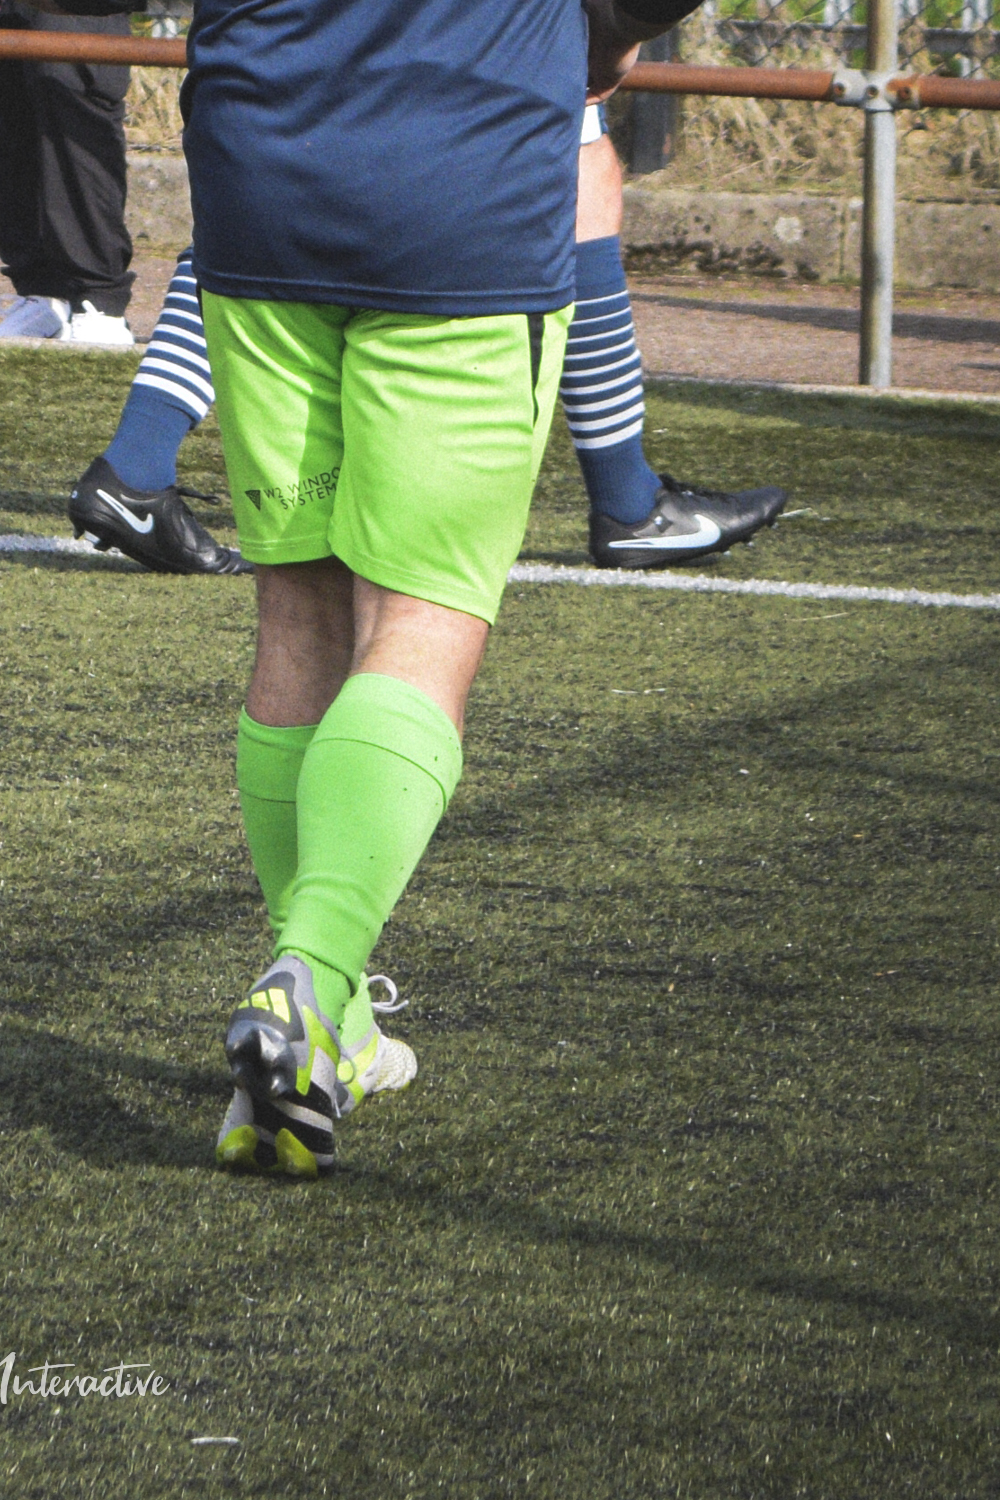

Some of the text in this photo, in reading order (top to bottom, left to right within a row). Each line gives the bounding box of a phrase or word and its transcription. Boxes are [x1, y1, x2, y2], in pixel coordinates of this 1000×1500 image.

[264, 466, 341, 499] W2 WINDO
[280, 482, 338, 510] SYSTEM
